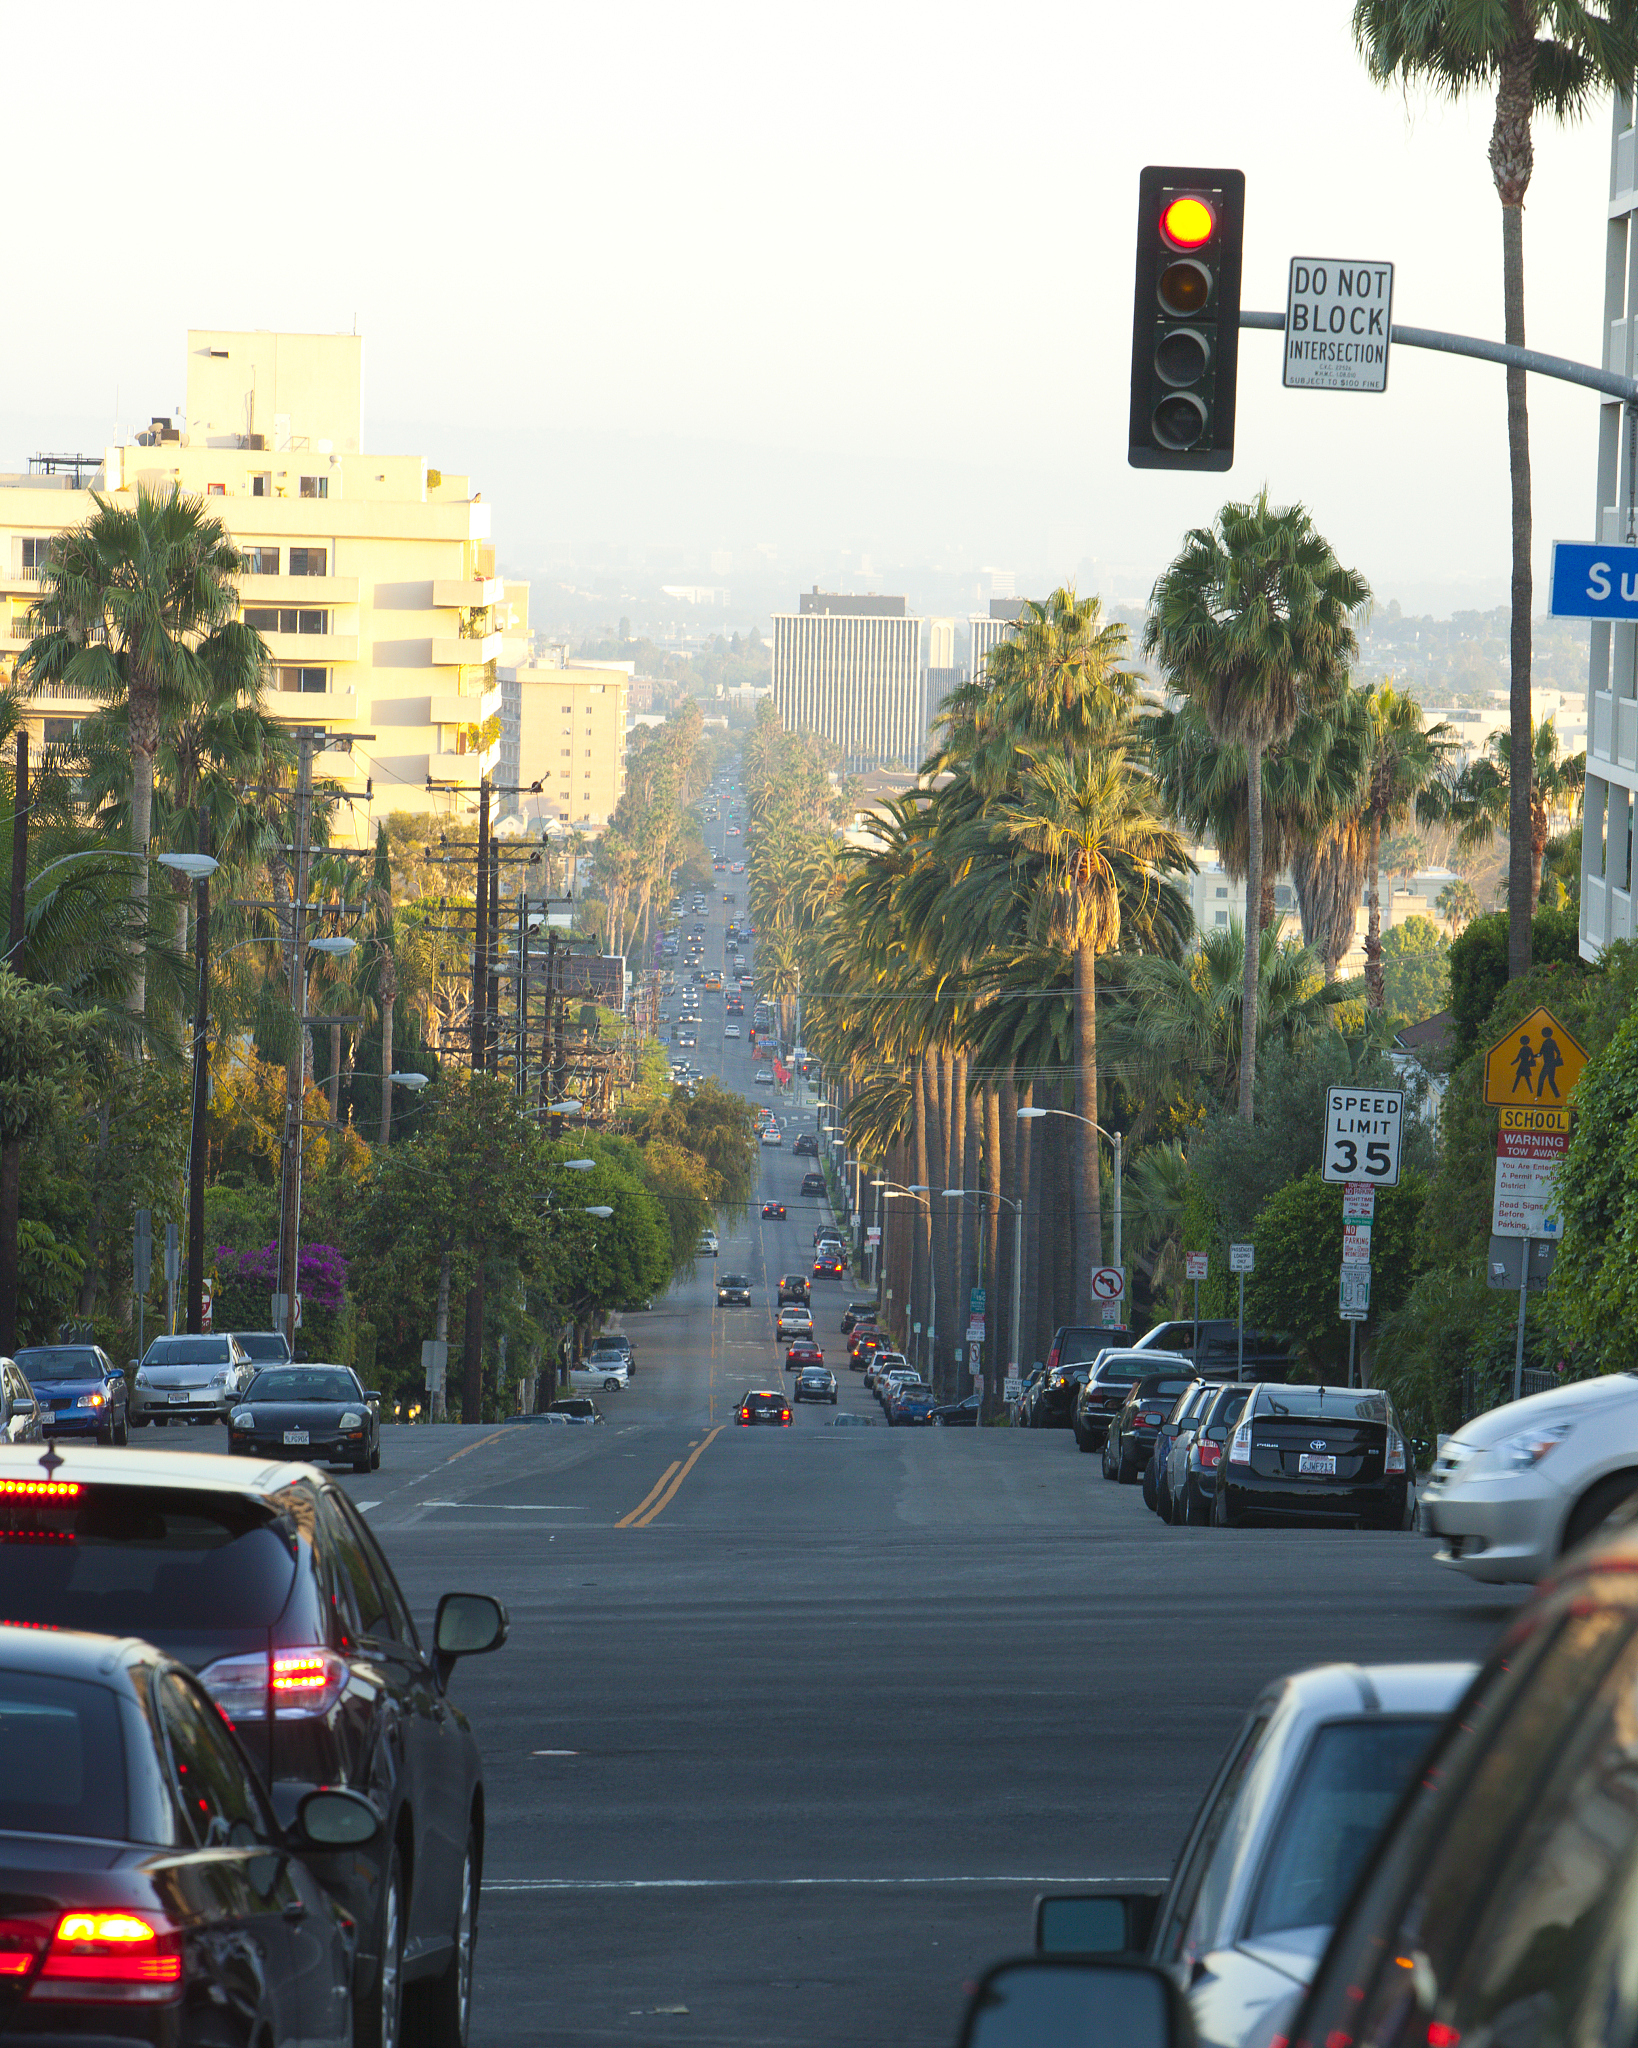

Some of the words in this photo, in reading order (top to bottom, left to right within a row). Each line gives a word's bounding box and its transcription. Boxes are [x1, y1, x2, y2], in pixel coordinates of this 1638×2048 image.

[1295, 266, 1327, 295] DO
[1337, 268, 1387, 299] NOT
[1292, 303, 1384, 336] BLOCK
[1290, 340, 1384, 364] INTERSECTION
[1290, 376, 1325, 385] SUBJECT
[1328, 378, 1338, 386] TO
[1340, 379, 1359, 387] $100
[1362, 380, 1380, 388] FINE
[1332, 1096, 1398, 1114] SPEED
[1504, 1110, 1565, 1129] SCHOOL
[1337, 1118, 1391, 1135] LIMIT
[1504, 1133, 1564, 1147] WARNING
[1331, 1139, 1392, 1176] 35
[1507, 1147, 1529, 1156] TOW
[1533, 1148, 1559, 1158] AWAY
[1517, 1162, 1530, 1170] Are
[1509, 1172, 1532, 1180] Permit
[1500, 1181, 1526, 1189] District
[1499, 1201, 1519, 1209] Read
[1522, 1201, 1544, 1211] Signs
[1498, 1210, 1525, 1218] Before
[1345, 1225, 1355, 1235] NO
[1345, 1236, 1369, 1245] PARKING
